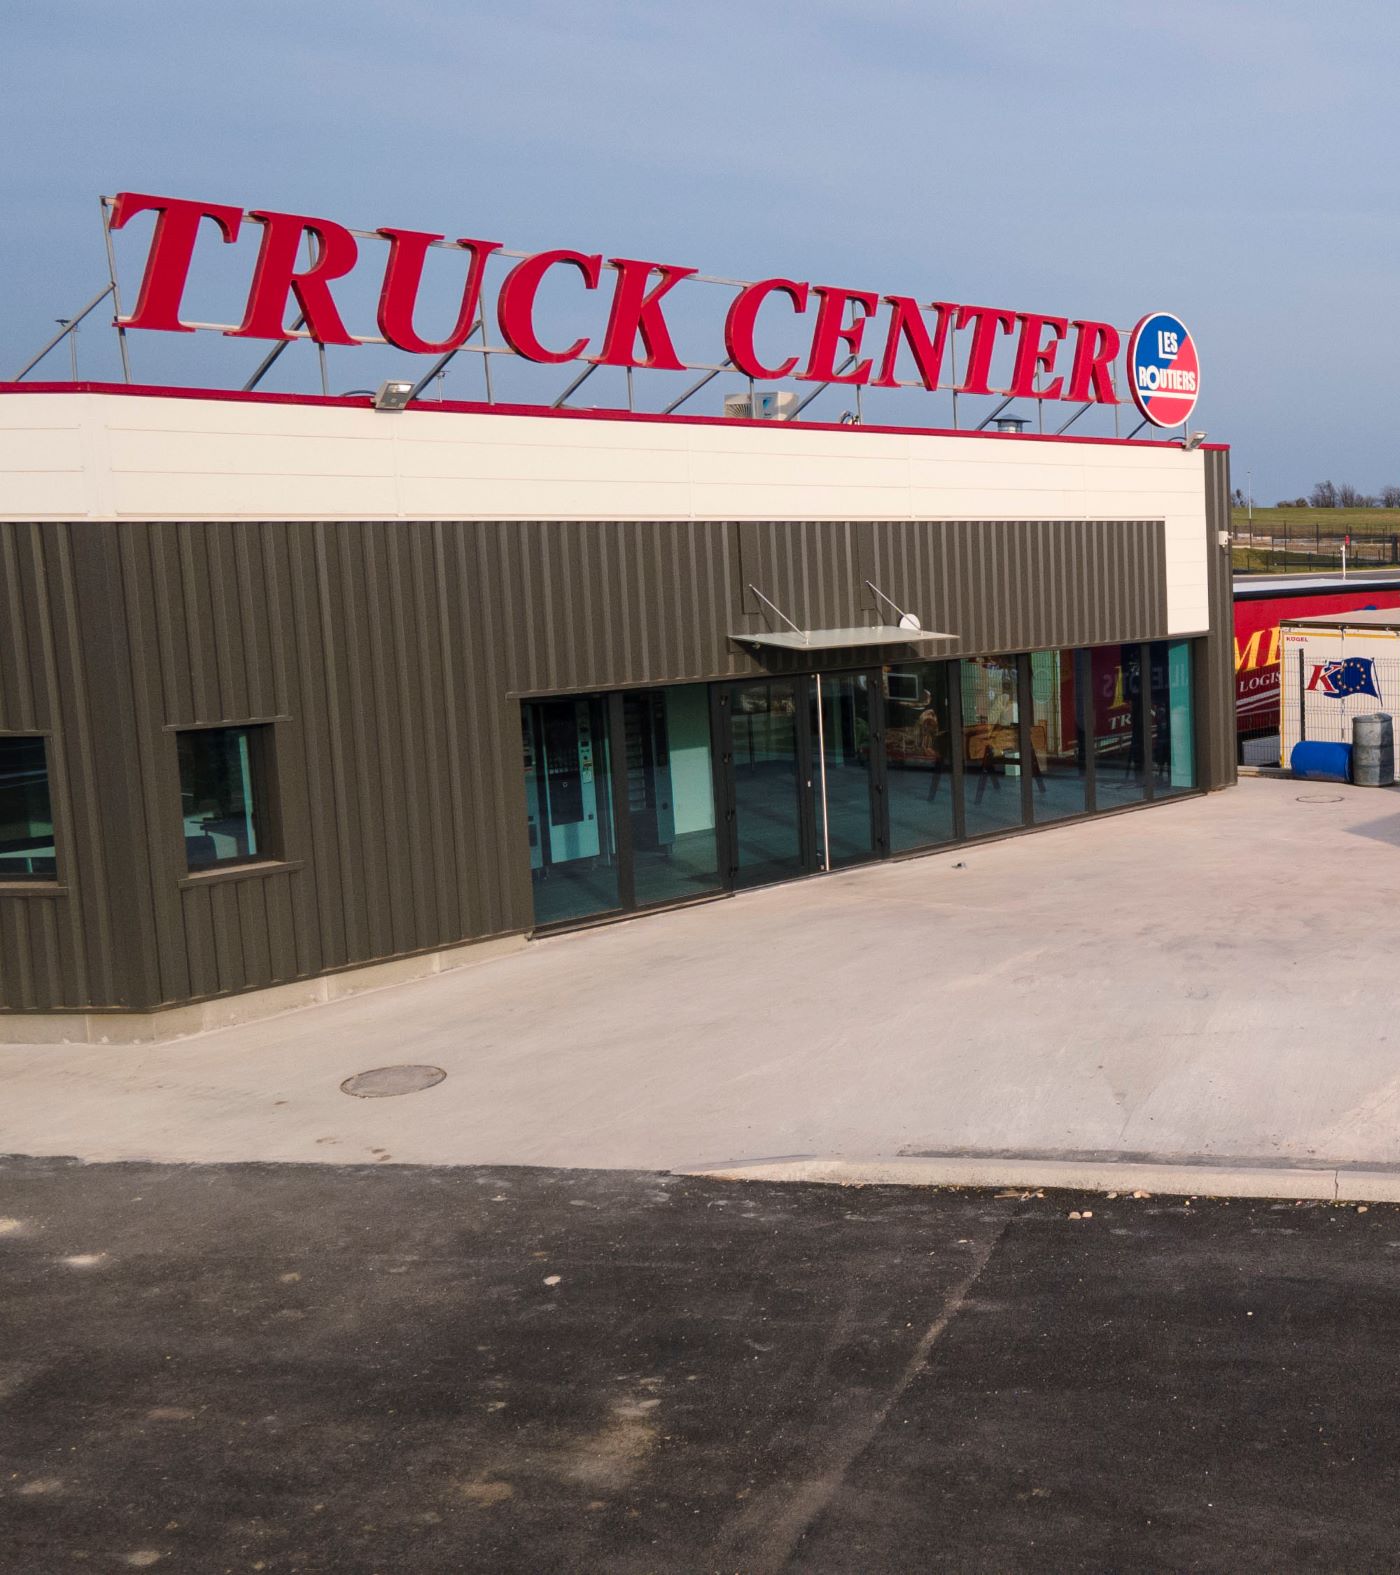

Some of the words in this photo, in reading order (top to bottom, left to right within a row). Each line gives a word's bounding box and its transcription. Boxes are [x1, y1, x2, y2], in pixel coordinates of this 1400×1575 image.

[109, 192, 698, 370] TRUCK
[725, 278, 1121, 404] CENTER
[1158, 330, 1178, 359] LES
[1138, 365, 1196, 391] ROUTIERS
